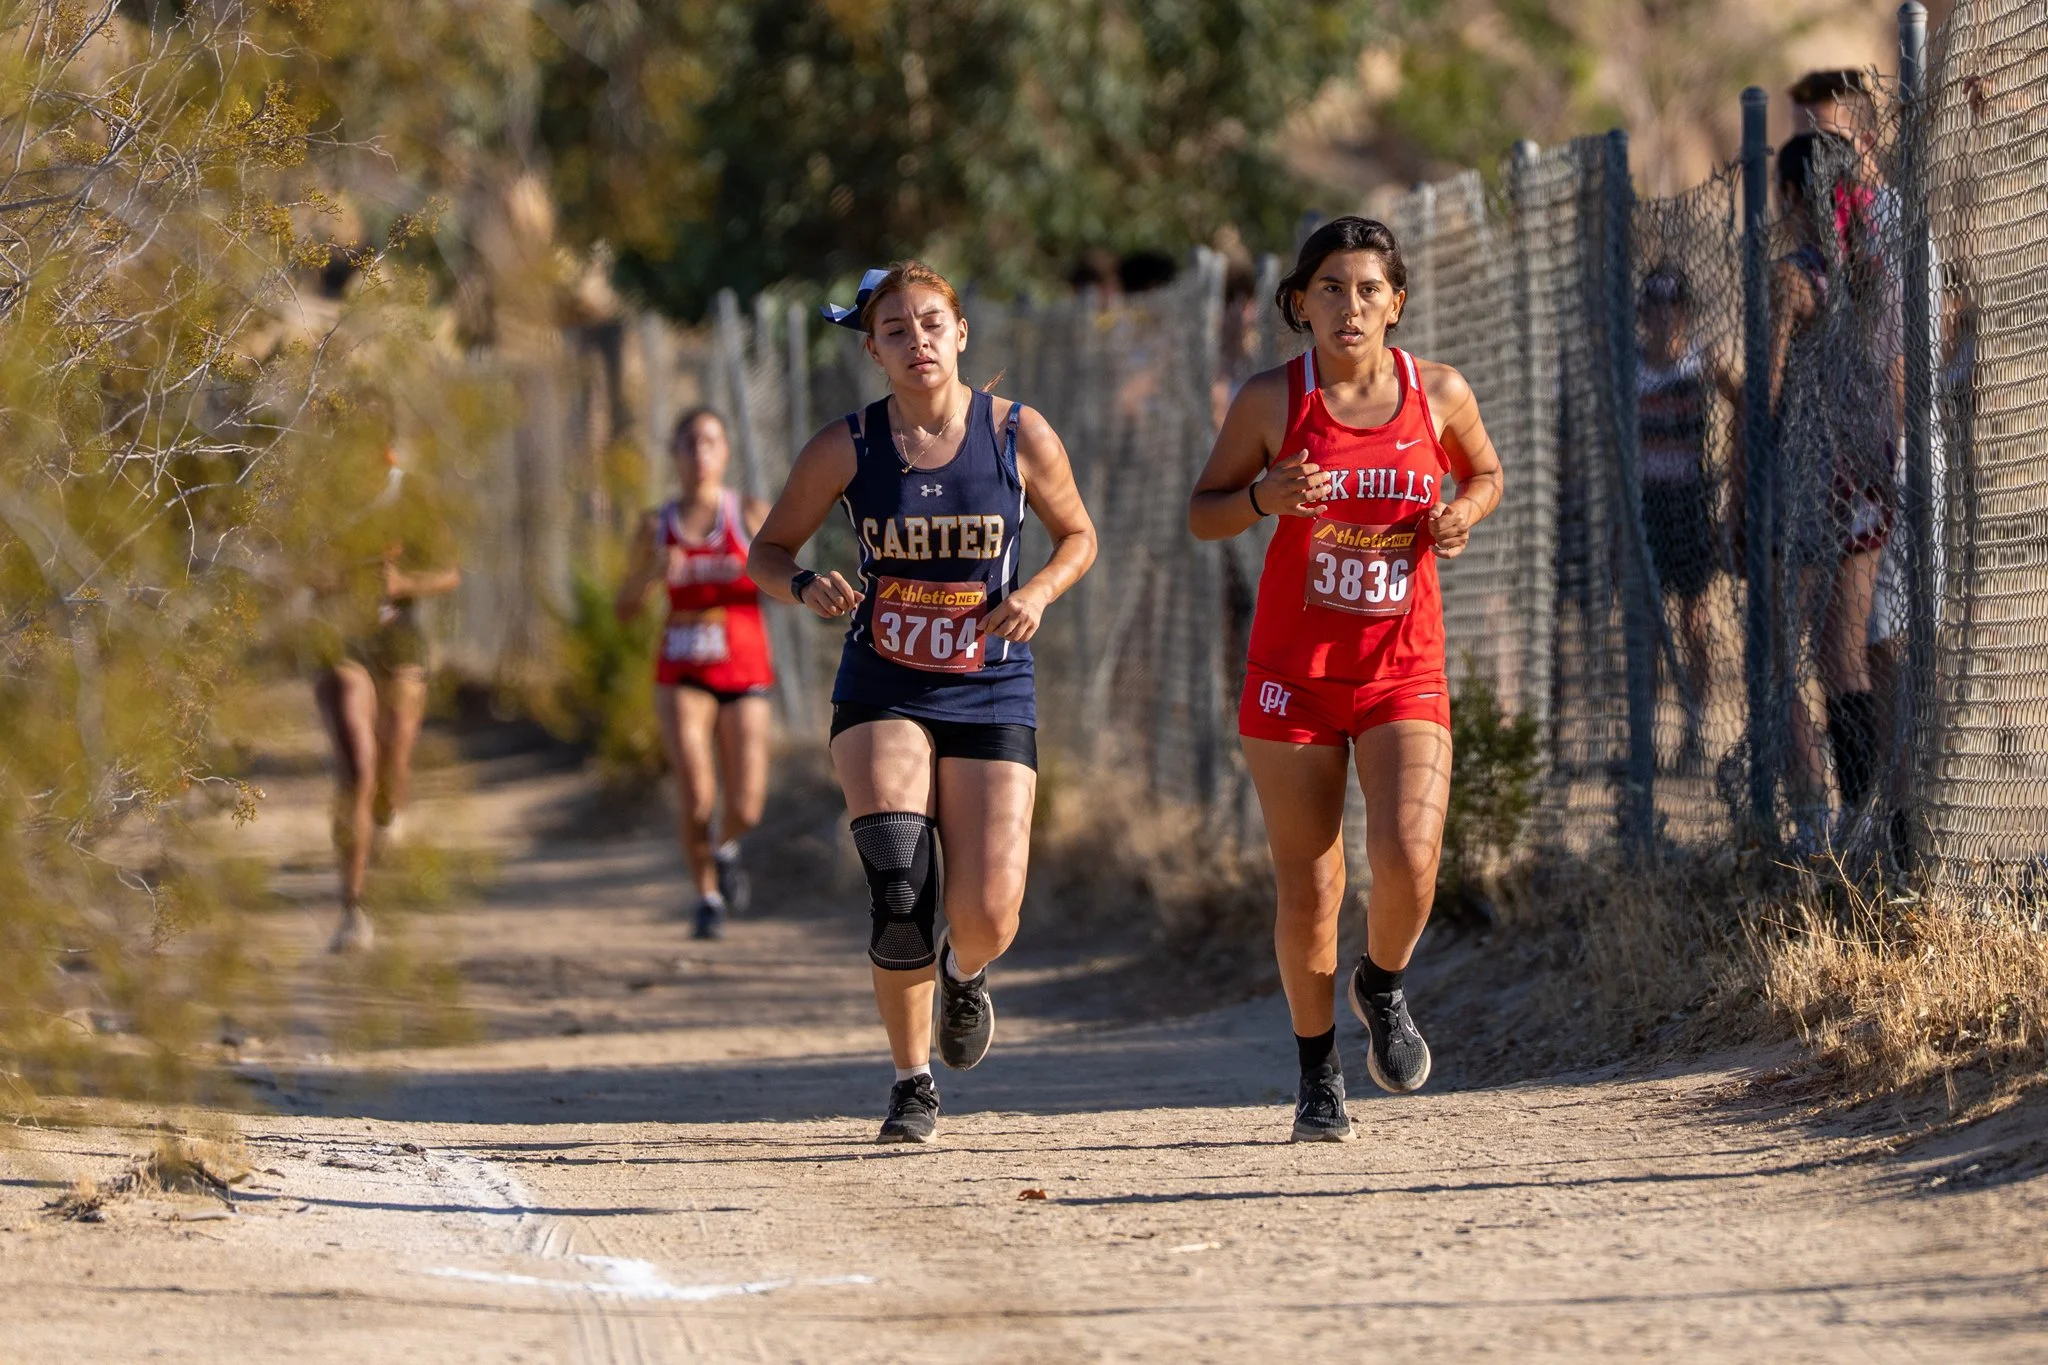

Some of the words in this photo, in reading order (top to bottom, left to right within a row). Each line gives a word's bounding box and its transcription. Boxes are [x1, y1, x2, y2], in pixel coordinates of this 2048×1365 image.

[1356, 468, 1434, 504] HILLS
[862, 514, 1005, 560] CARTER
[1313, 552, 1409, 603] 3836
[880, 612, 979, 659] 3764
